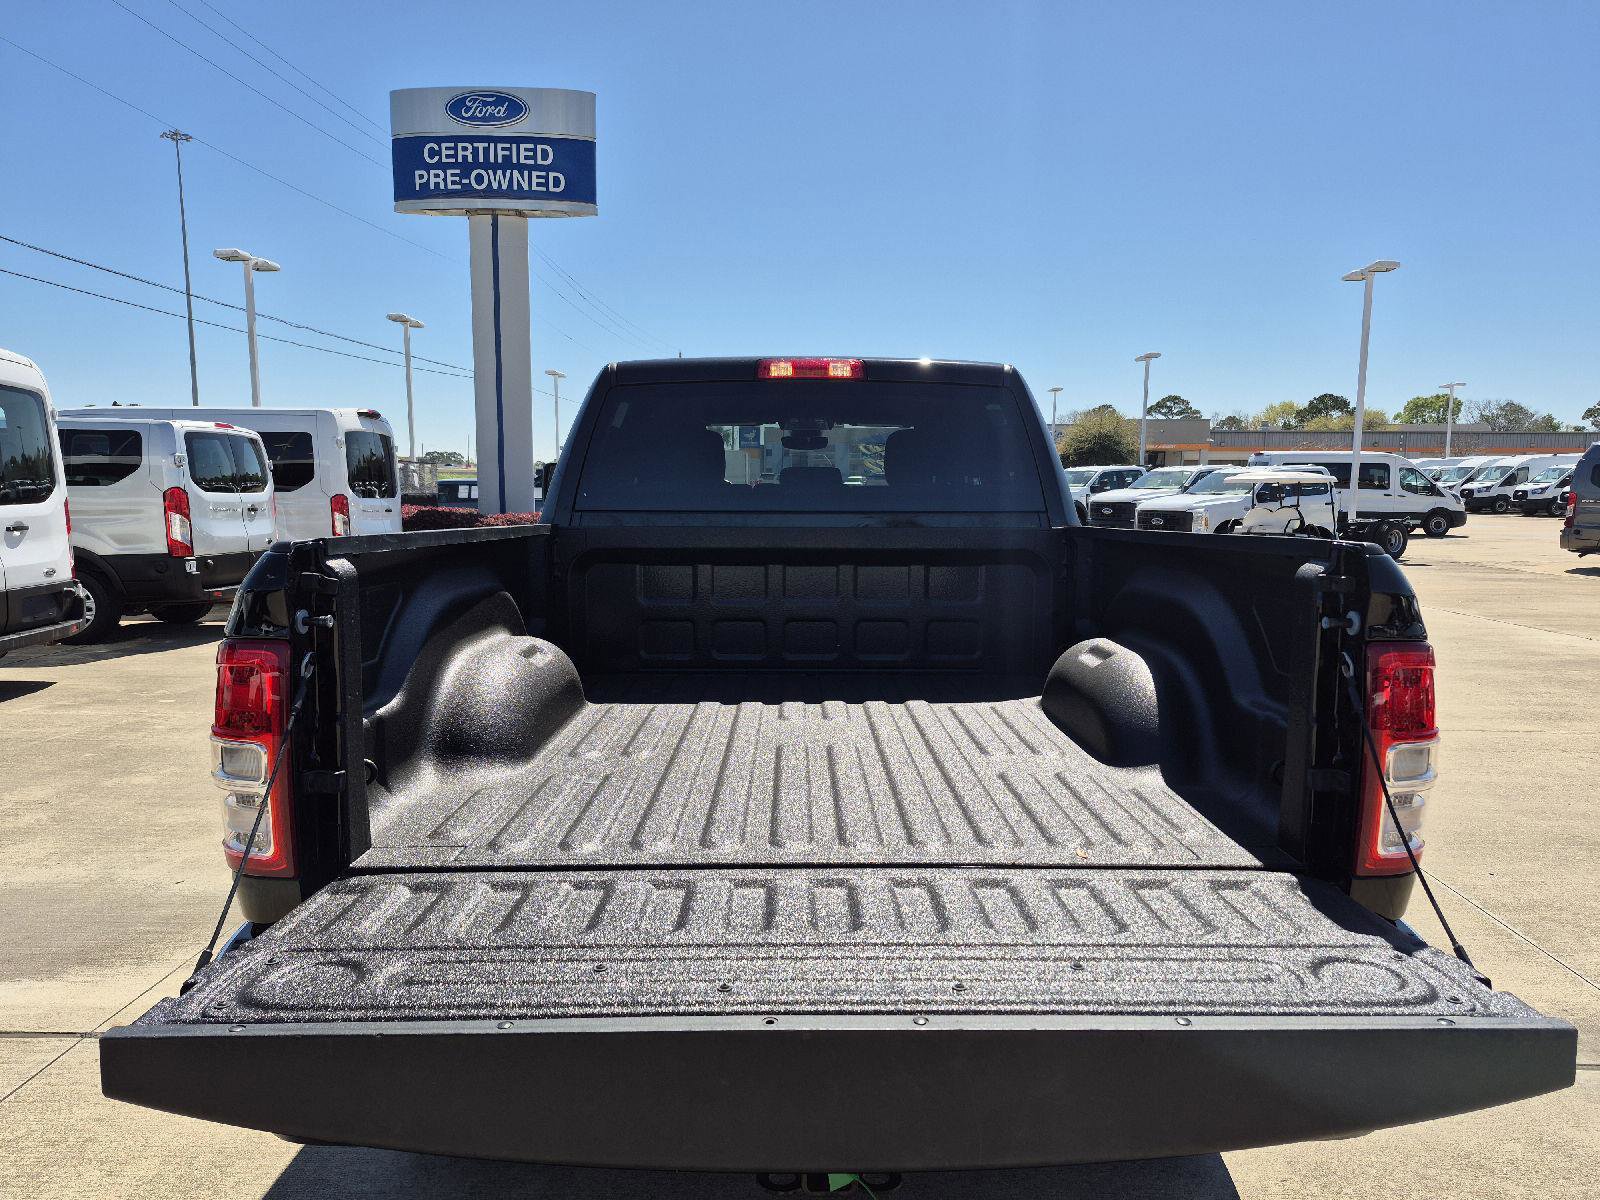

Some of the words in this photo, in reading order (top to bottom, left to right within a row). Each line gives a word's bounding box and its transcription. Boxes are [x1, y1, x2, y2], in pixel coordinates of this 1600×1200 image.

[462, 96, 508, 117] Ford
[423, 142, 554, 166] CERTIFIED
[414, 168, 566, 193] PRE-OWNED
